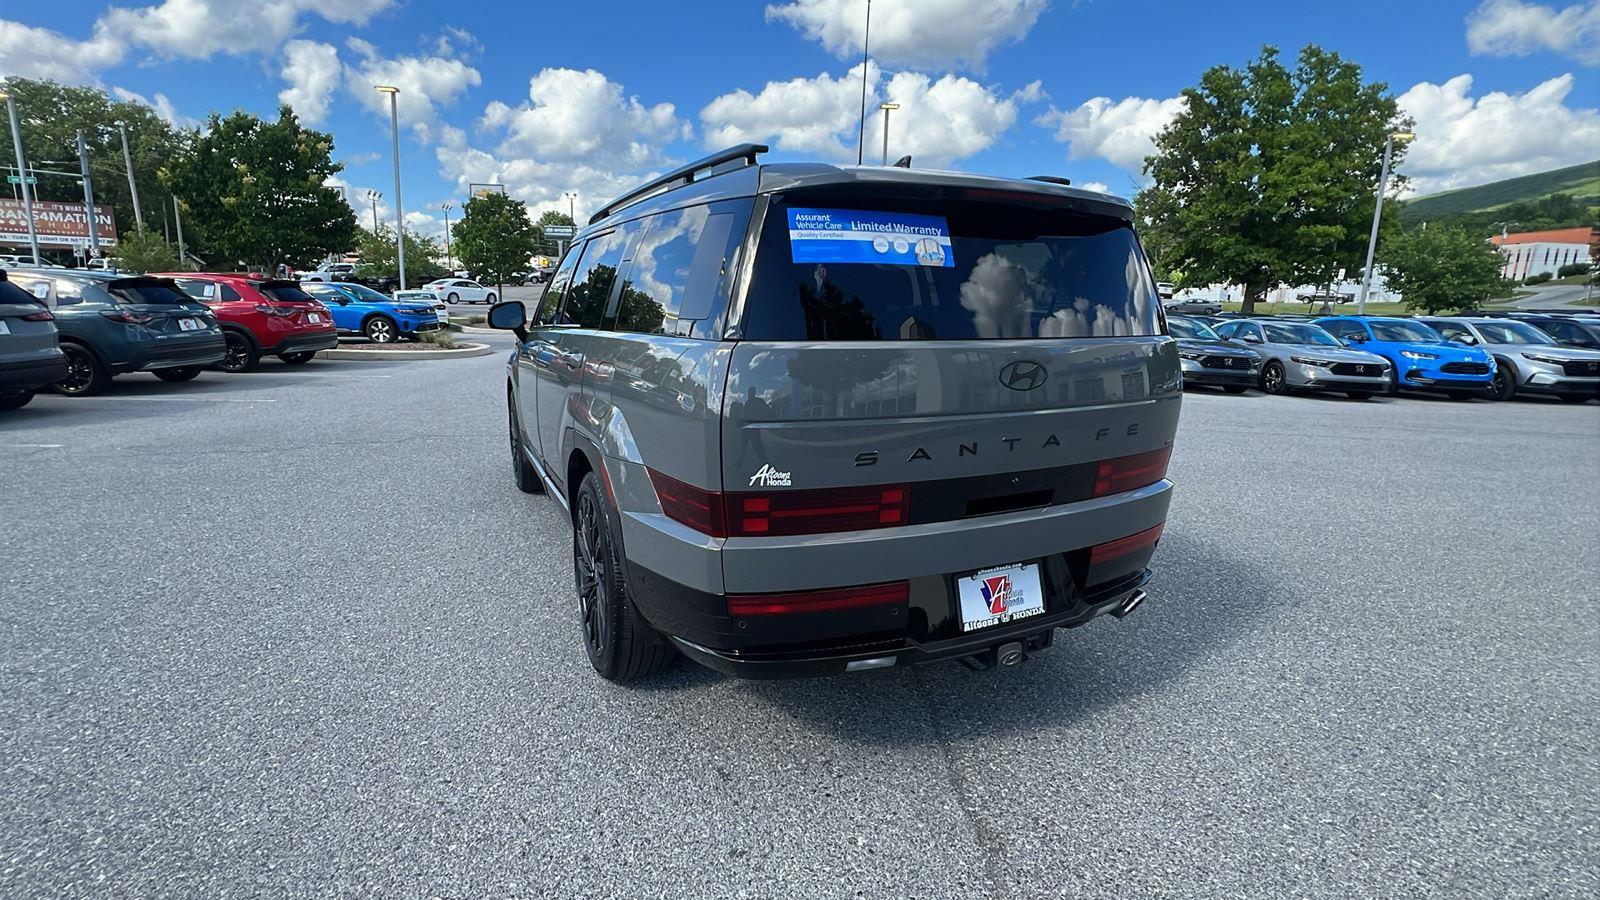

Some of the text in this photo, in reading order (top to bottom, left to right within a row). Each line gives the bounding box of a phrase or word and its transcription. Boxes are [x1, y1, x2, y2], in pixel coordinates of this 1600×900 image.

[795, 213, 831, 222] Assurant
[796, 221, 843, 230] Vehicle Care
[851, 220, 943, 236] Limited Warranty
[797, 231, 819, 239] Quality
[854, 423, 1139, 467] SANTA FE
[963, 616, 999, 632] Altoona
[1012, 606, 1046, 621] HONDA
